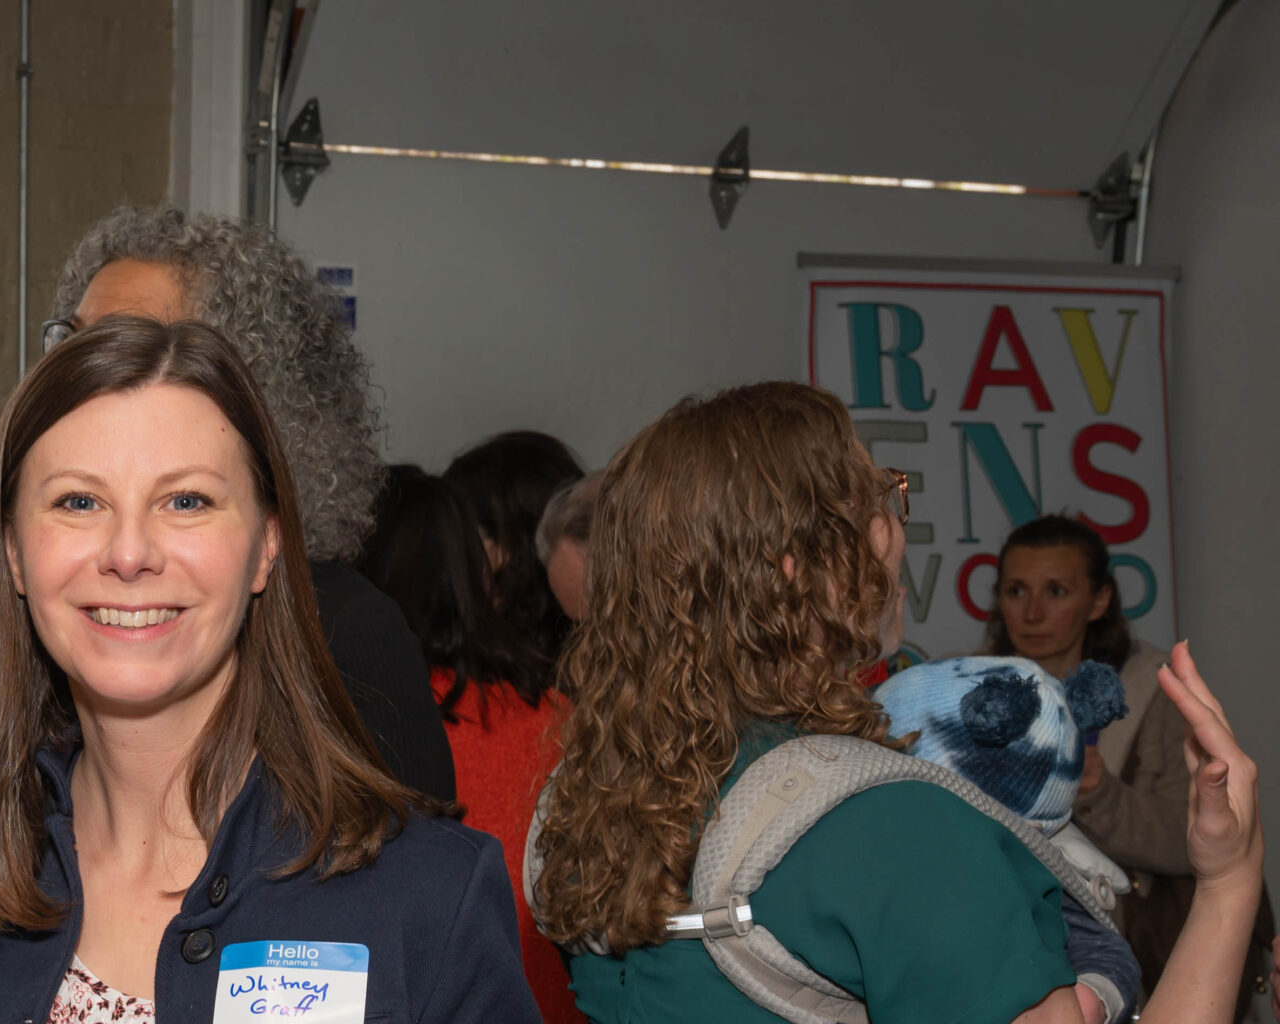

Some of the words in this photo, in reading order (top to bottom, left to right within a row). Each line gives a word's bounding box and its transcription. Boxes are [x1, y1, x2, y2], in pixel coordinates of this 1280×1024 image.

[837, 302, 1139, 415] RAV
[268, 943, 319, 960] Hello
[266, 959, 281, 967] my
[283, 959, 308, 967] name
[310, 959, 319, 967] is
[230, 974, 330, 1002] Whitney
